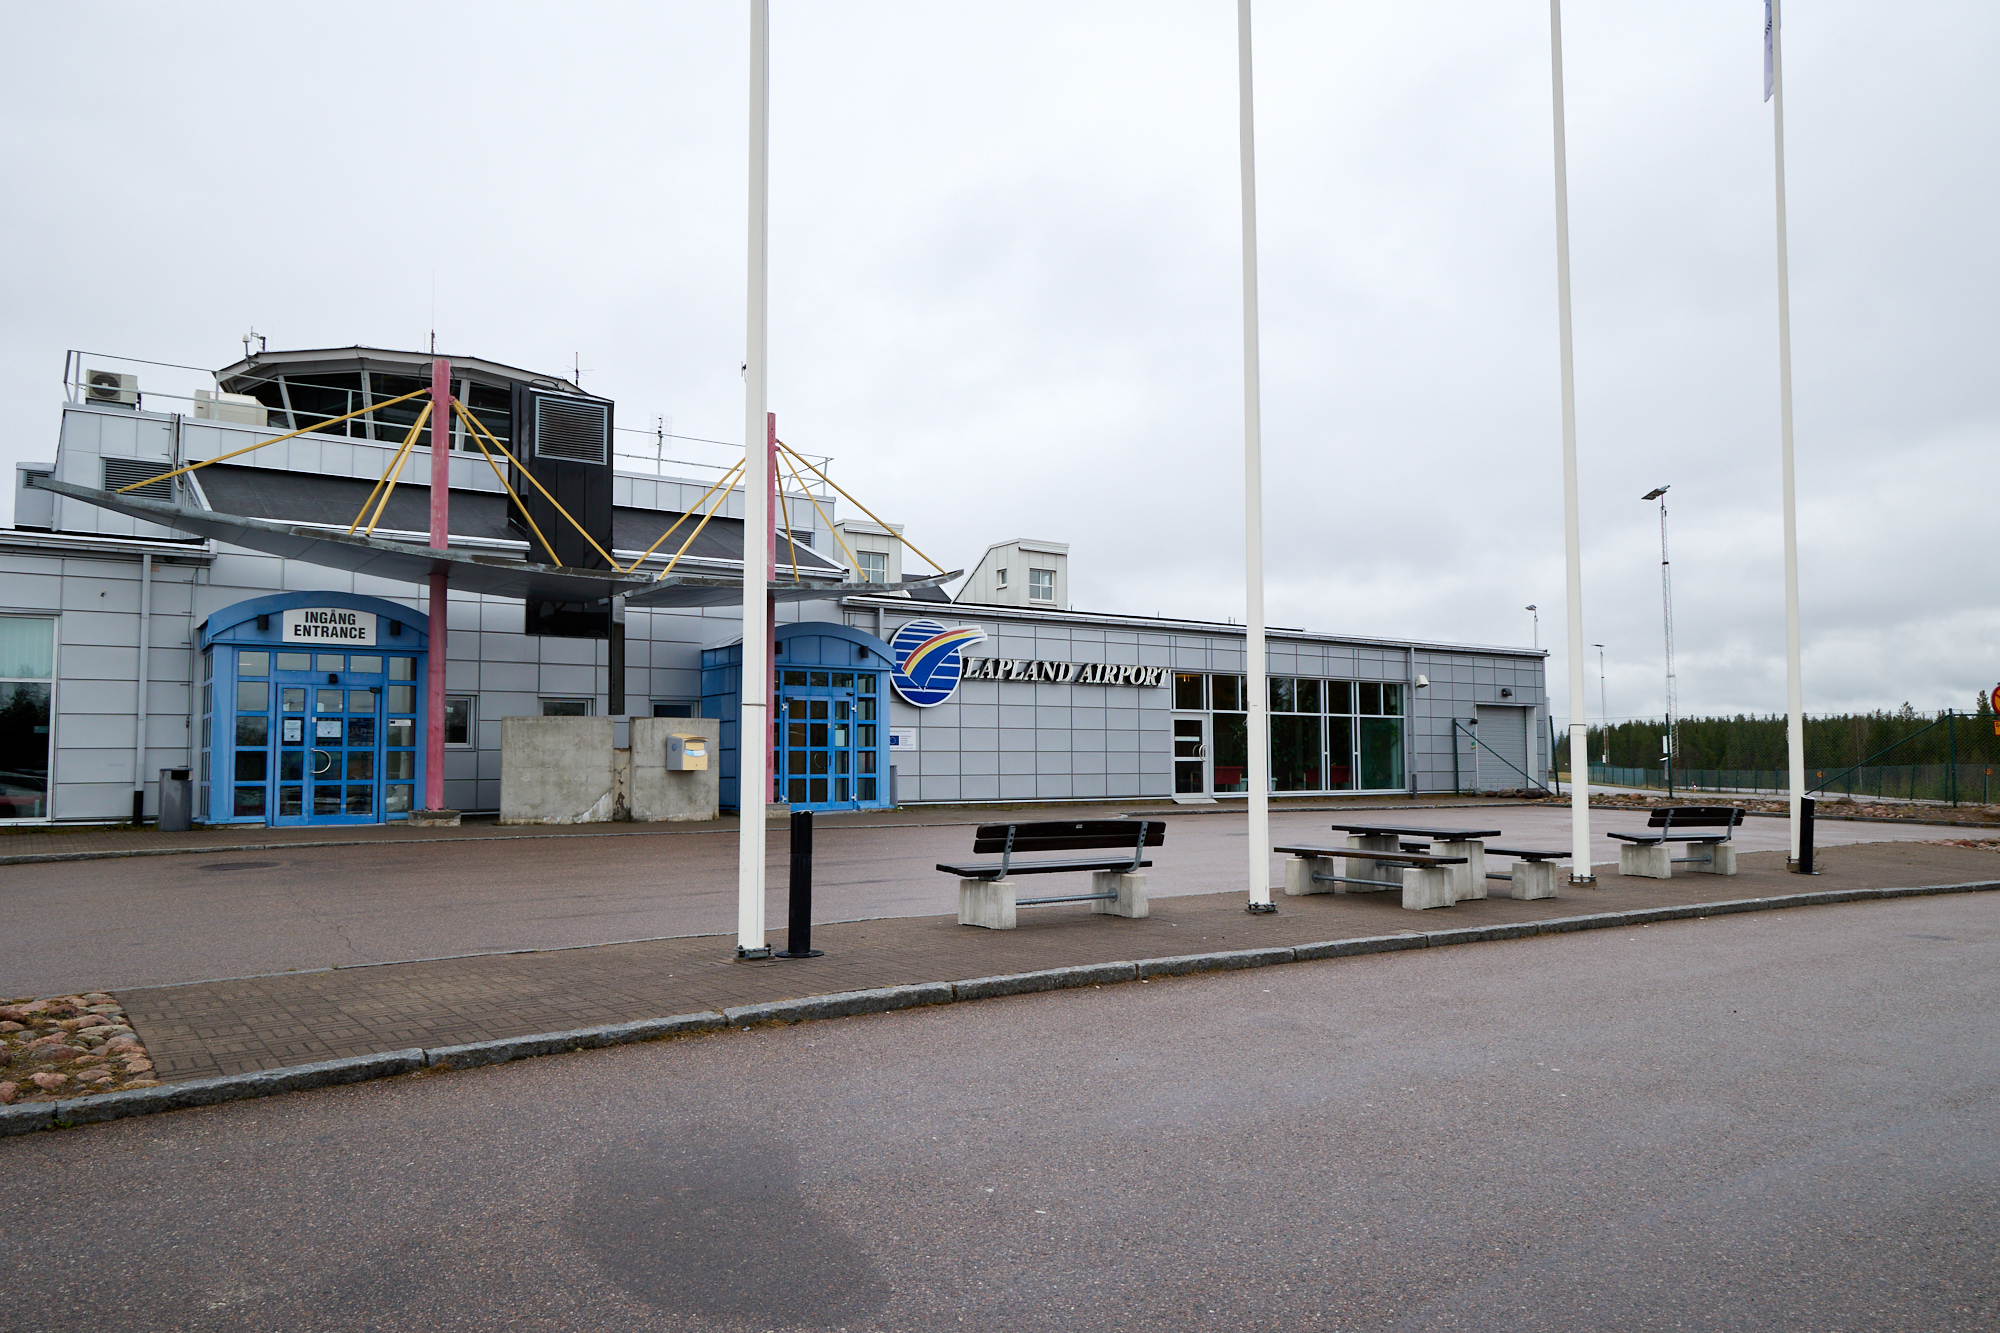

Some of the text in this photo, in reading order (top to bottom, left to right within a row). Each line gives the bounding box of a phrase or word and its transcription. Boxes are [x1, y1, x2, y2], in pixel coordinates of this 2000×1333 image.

[305, 609, 356, 625] INGÅNG
[294, 624, 366, 639] ENTRANCE
[963, 656, 1171, 687] LAPLAND AIRPORT
